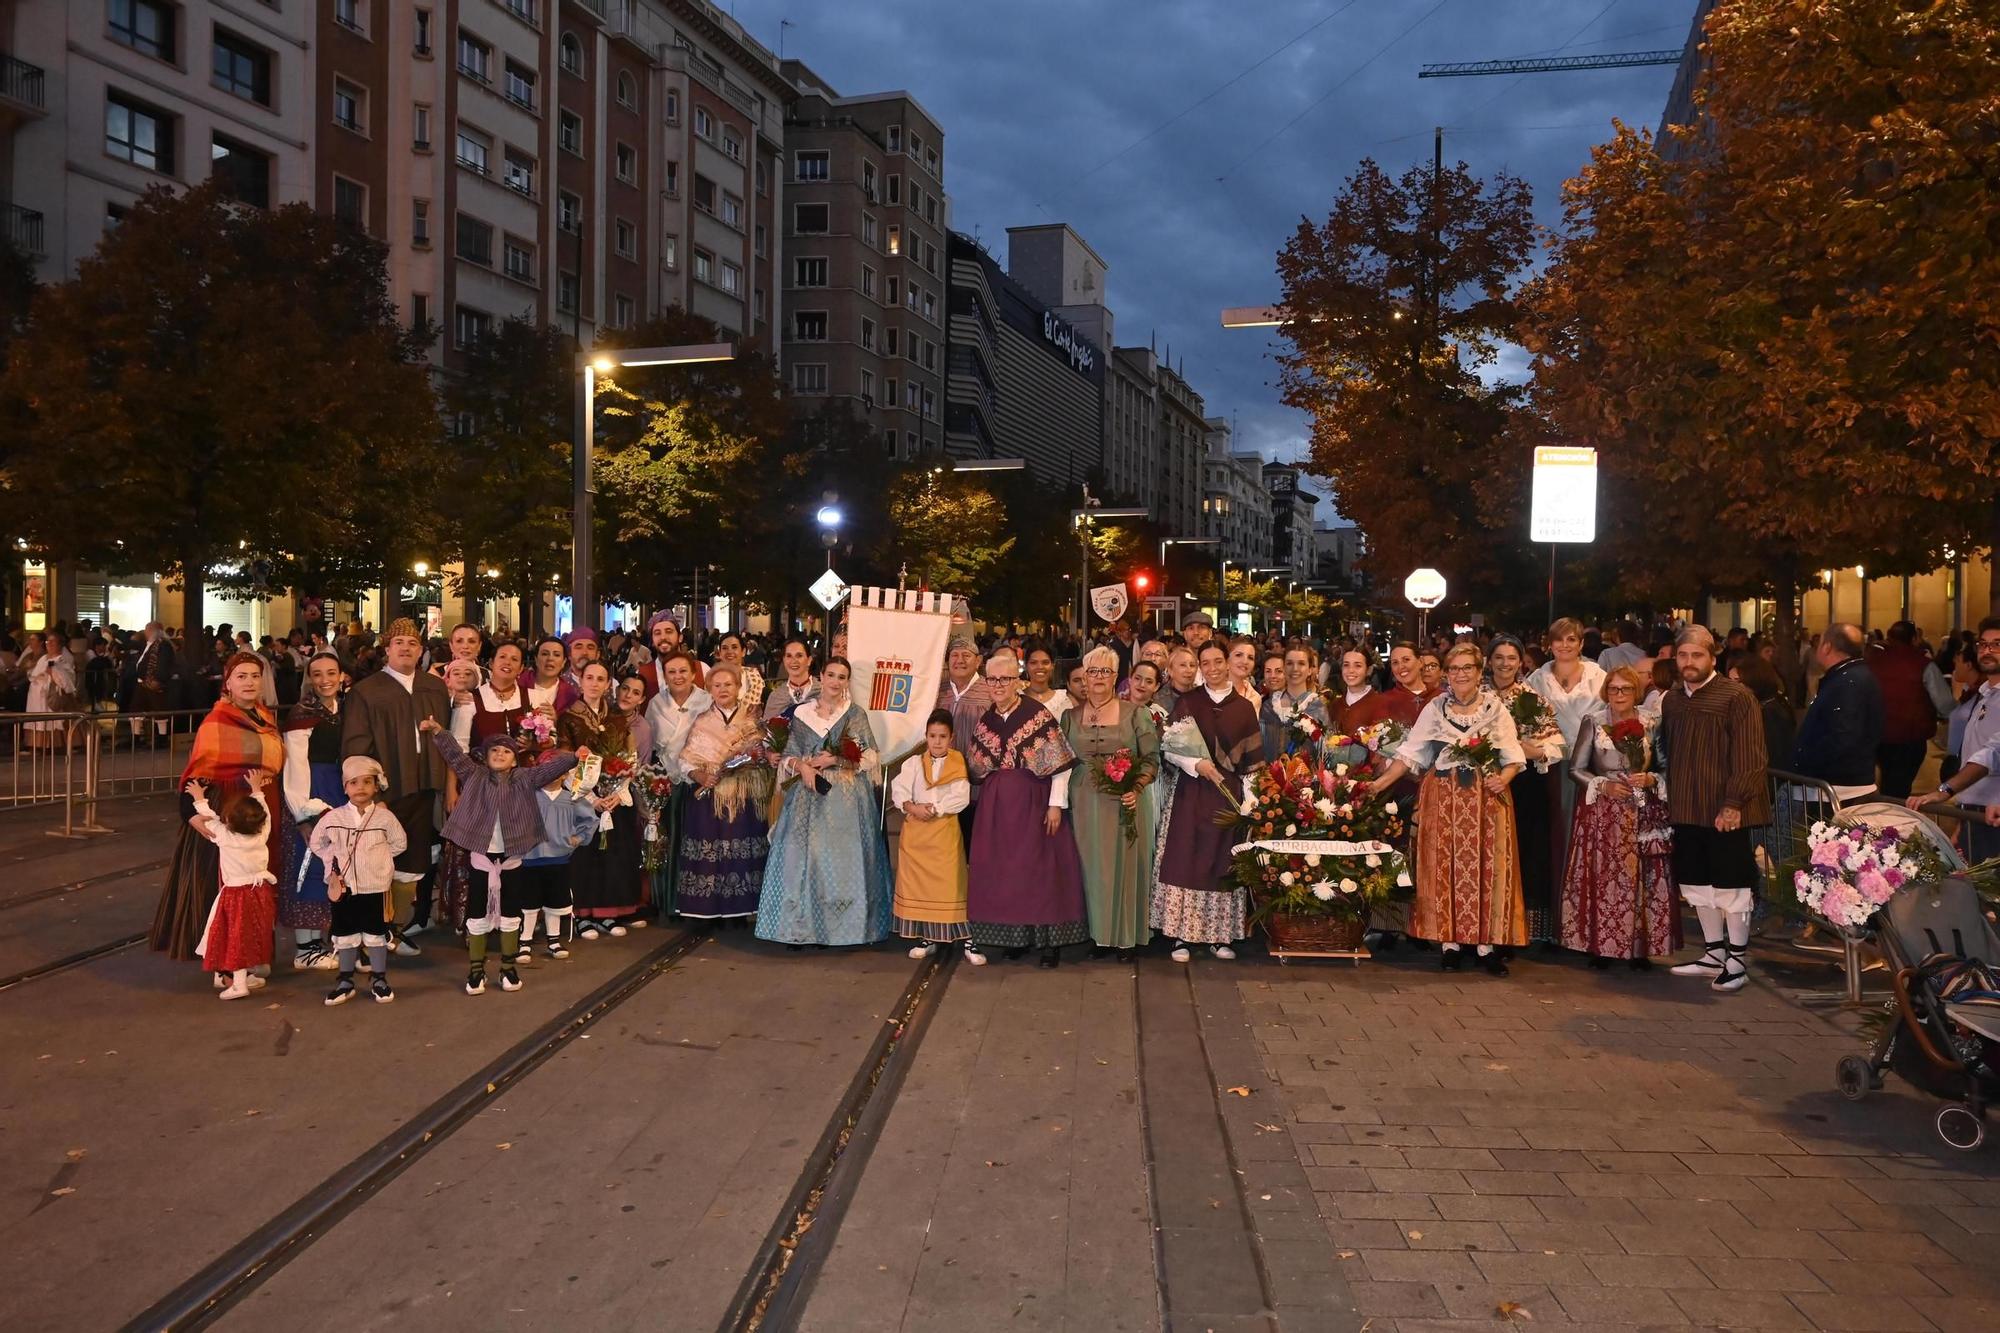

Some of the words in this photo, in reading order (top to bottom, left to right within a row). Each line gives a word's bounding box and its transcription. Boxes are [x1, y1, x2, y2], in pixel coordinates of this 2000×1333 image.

[1044, 311, 1053, 341] El
[1053, 319, 1071, 353] Corte
[890, 677, 907, 708] B
